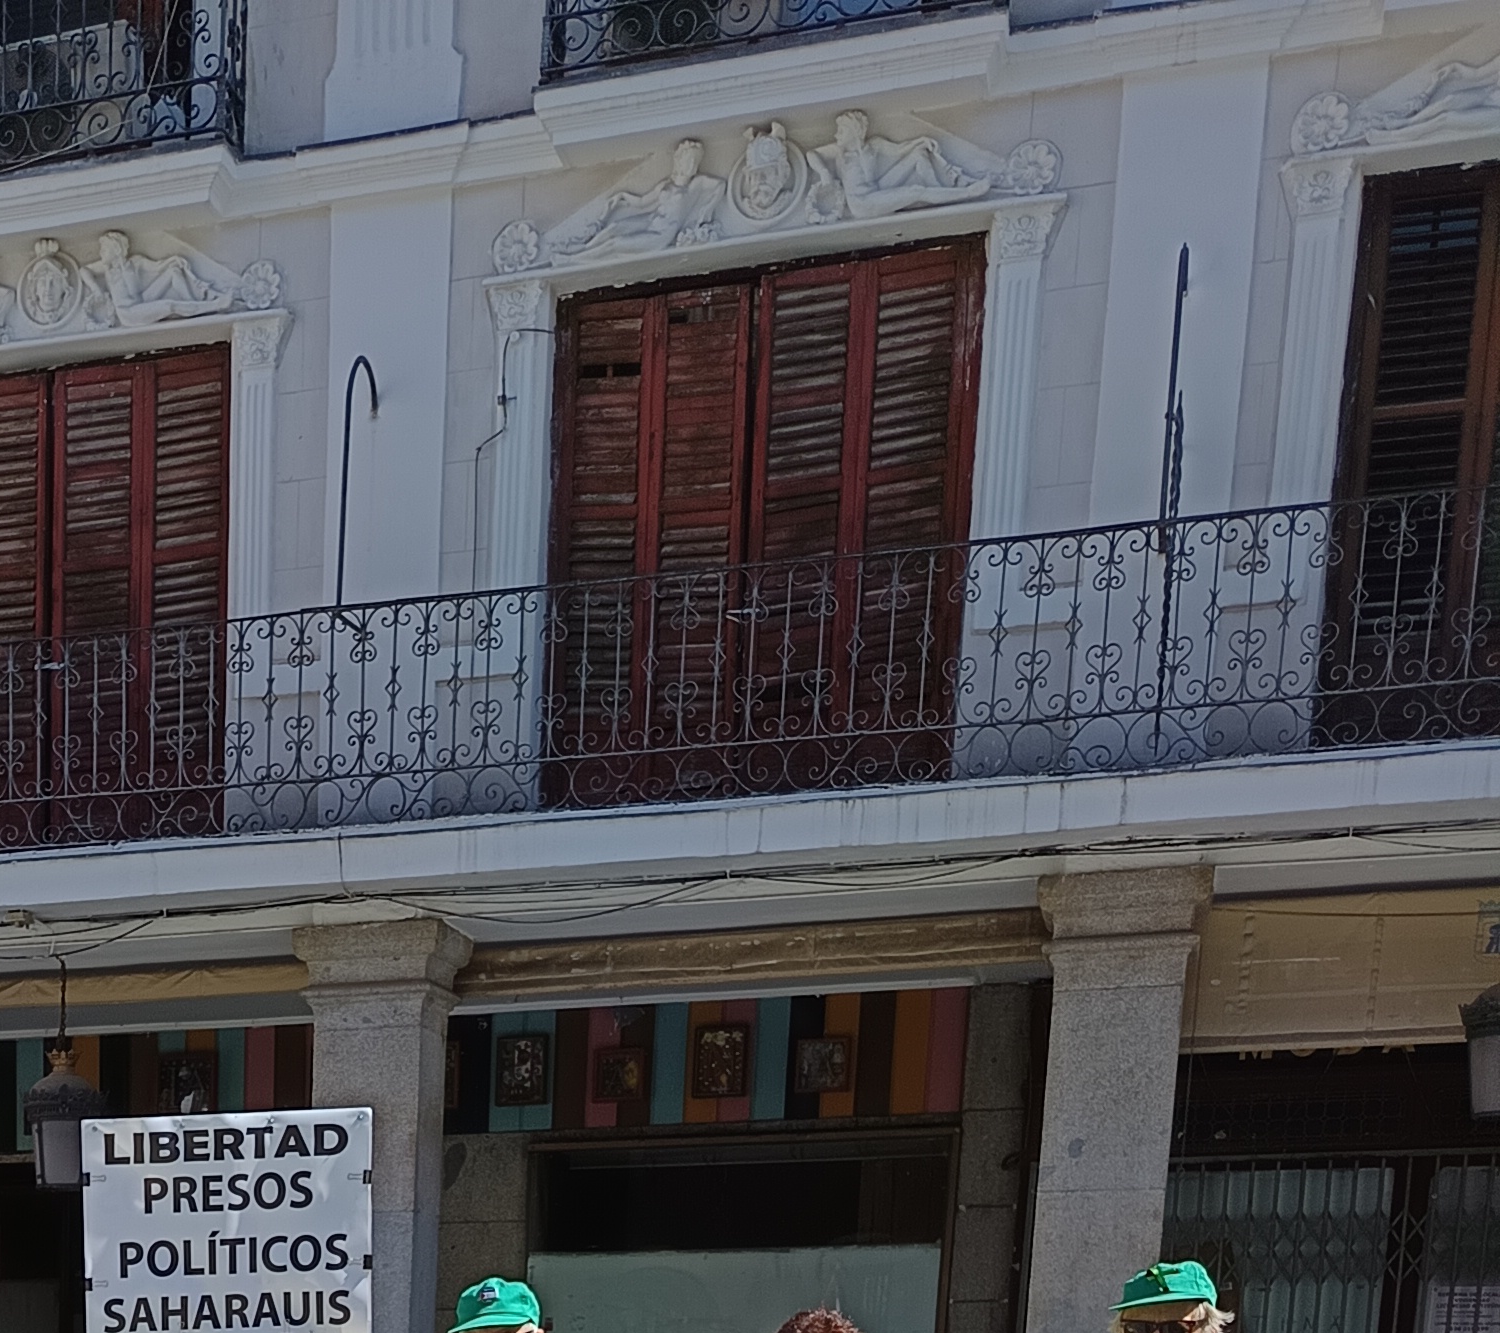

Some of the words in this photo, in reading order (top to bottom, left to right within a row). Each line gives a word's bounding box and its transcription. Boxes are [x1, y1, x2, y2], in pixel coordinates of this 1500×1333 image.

[104, 1124, 348, 1165] LIBERTAD
[144, 1170, 313, 1214] PRESOS
[119, 1230, 348, 1278] POLÍTICOS
[103, 1290, 351, 1333] SAHARAUIS
